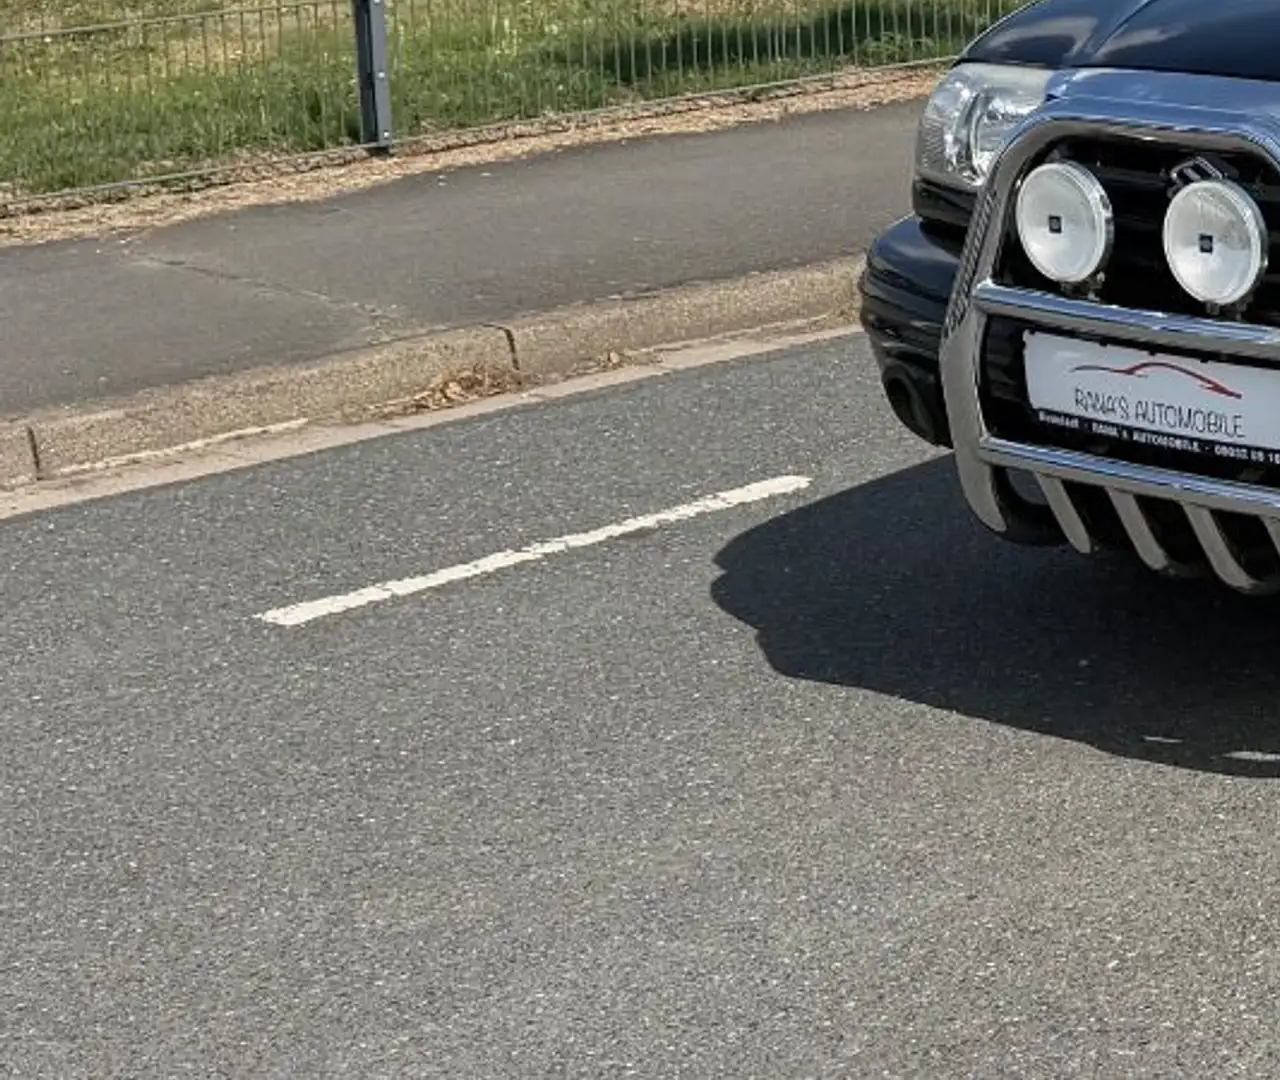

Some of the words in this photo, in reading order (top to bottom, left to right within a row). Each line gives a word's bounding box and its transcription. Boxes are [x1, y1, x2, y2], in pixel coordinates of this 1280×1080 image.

[1075, 386, 1129, 420] RANA'S
[1135, 400, 1246, 438] AUTOMOBILE
[1132, 429, 1200, 453] AUTOMOBILE
